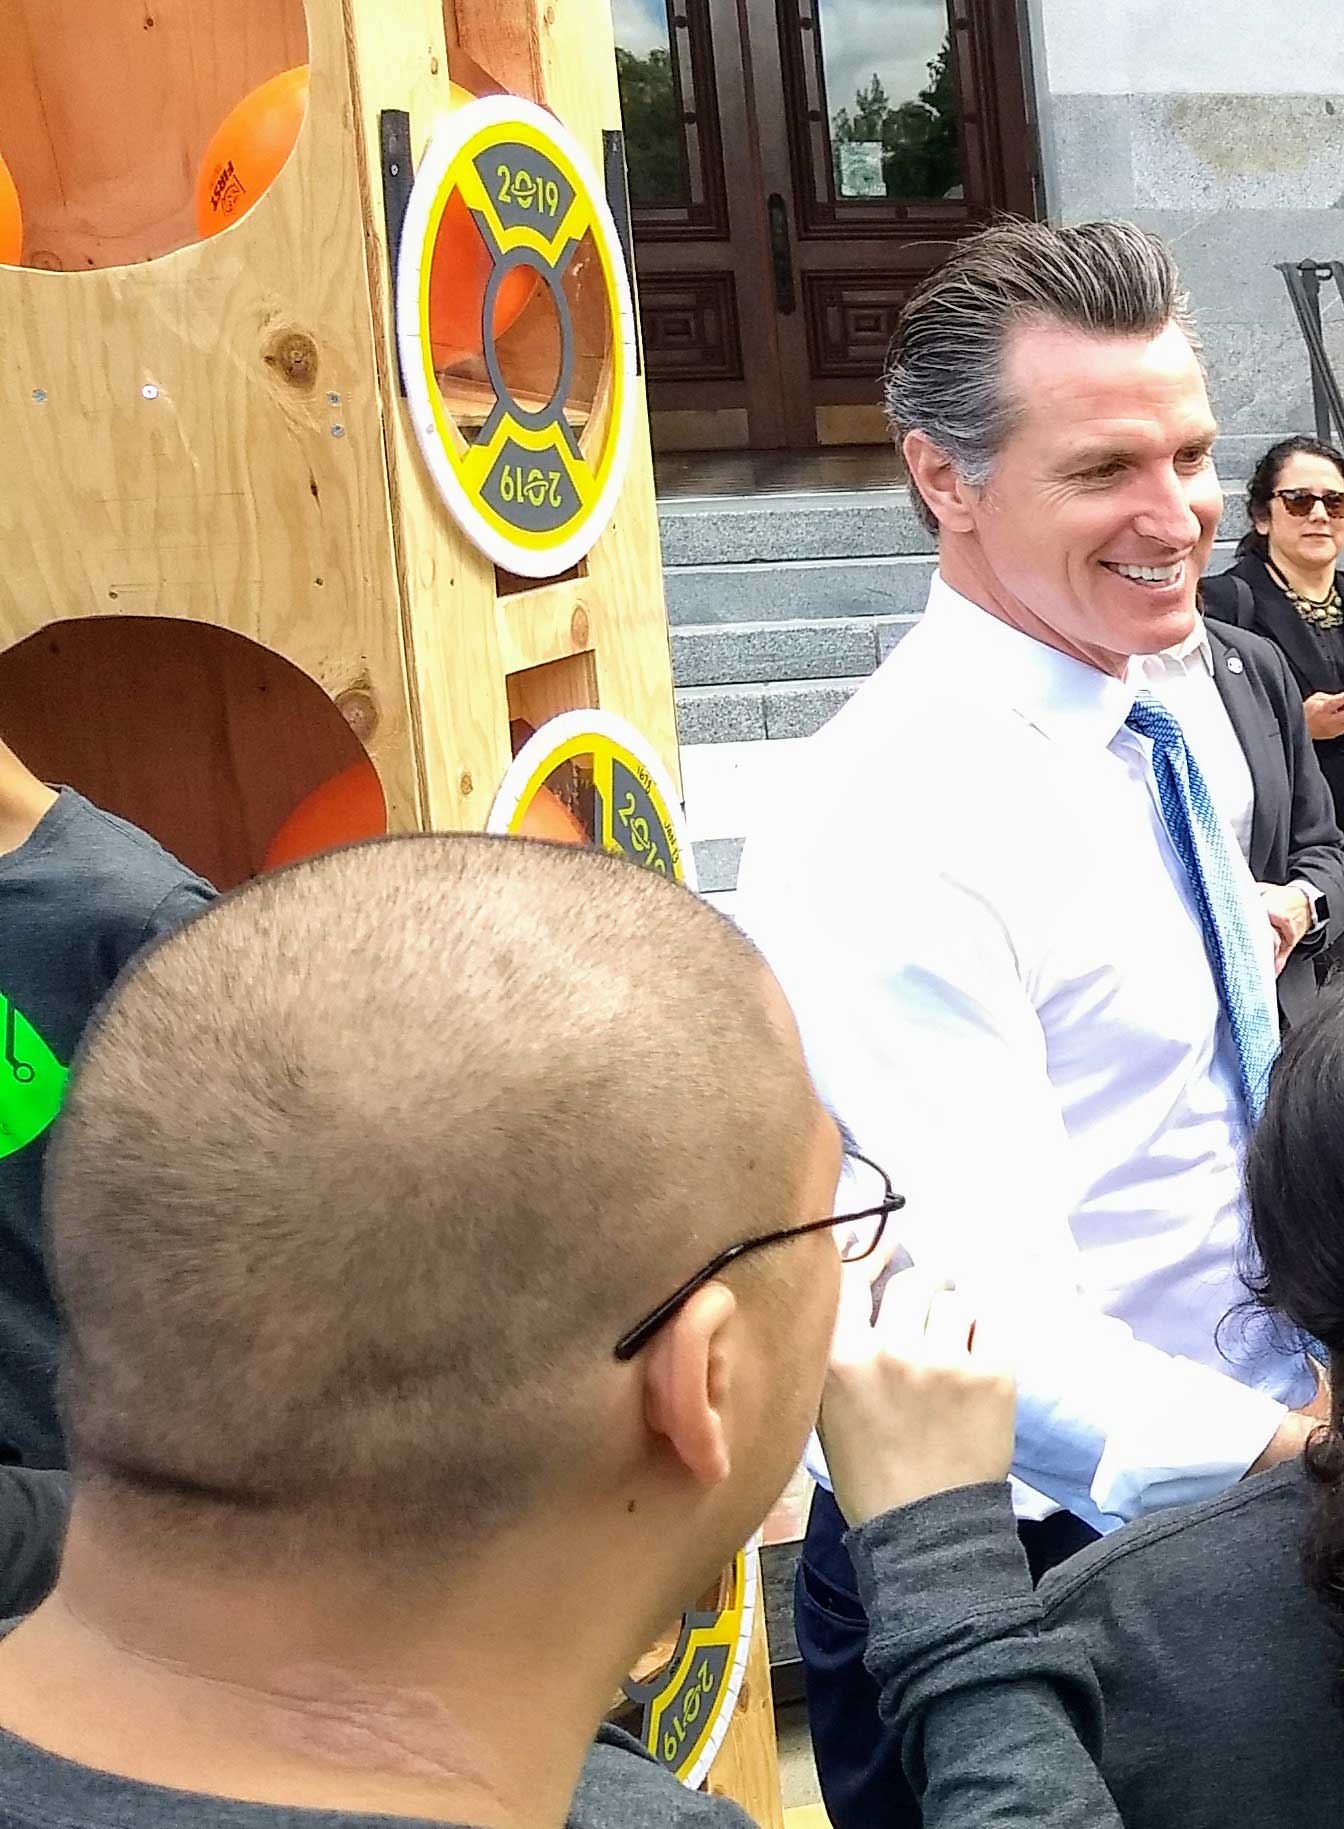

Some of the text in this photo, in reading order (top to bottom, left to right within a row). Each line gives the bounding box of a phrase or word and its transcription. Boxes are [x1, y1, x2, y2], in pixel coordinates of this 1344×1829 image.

[211, 160, 234, 212] FIRST
[497, 165, 559, 217] 2019
[500, 465, 562, 508] 2019
[663, 1658, 714, 1762] 2019
